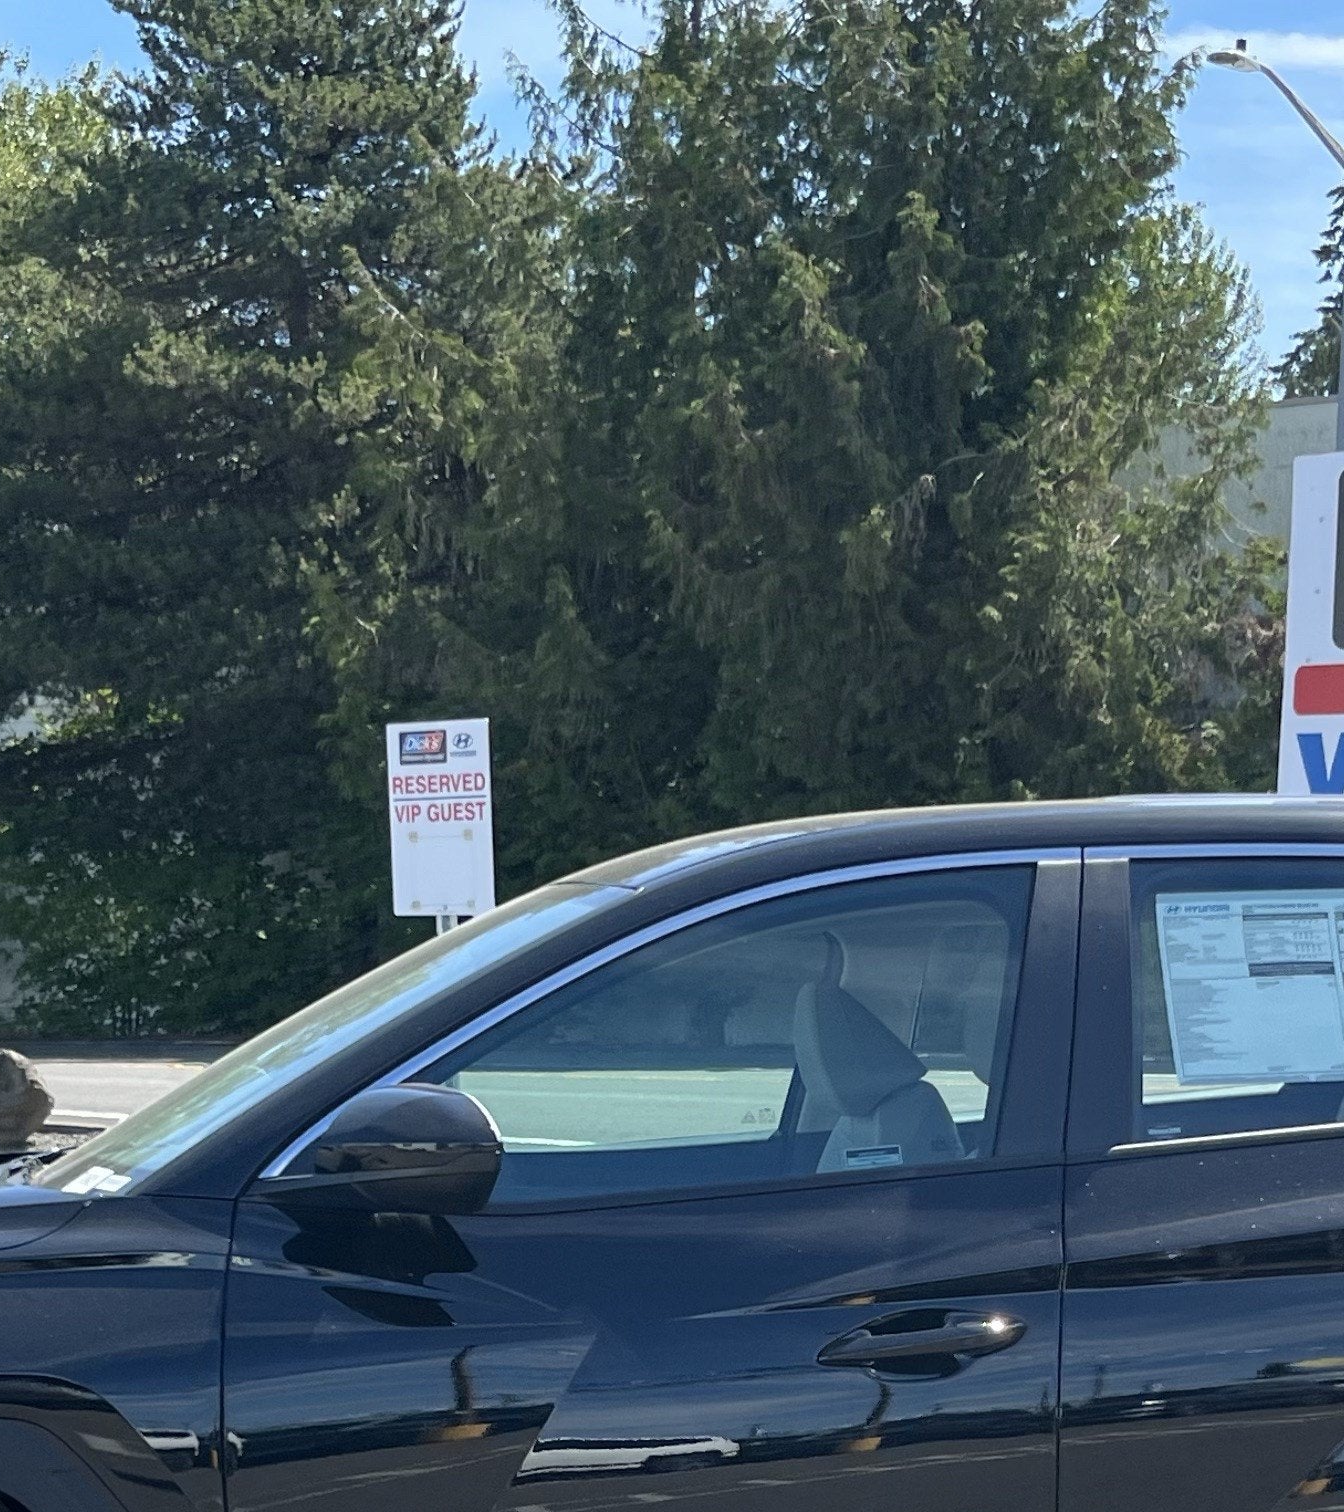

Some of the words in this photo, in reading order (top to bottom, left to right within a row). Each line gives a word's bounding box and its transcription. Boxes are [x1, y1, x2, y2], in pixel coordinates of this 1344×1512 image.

[392, 773, 486, 794] RESERVED
[394, 803, 421, 823] VIP
[427, 802, 486, 822] GUEST
